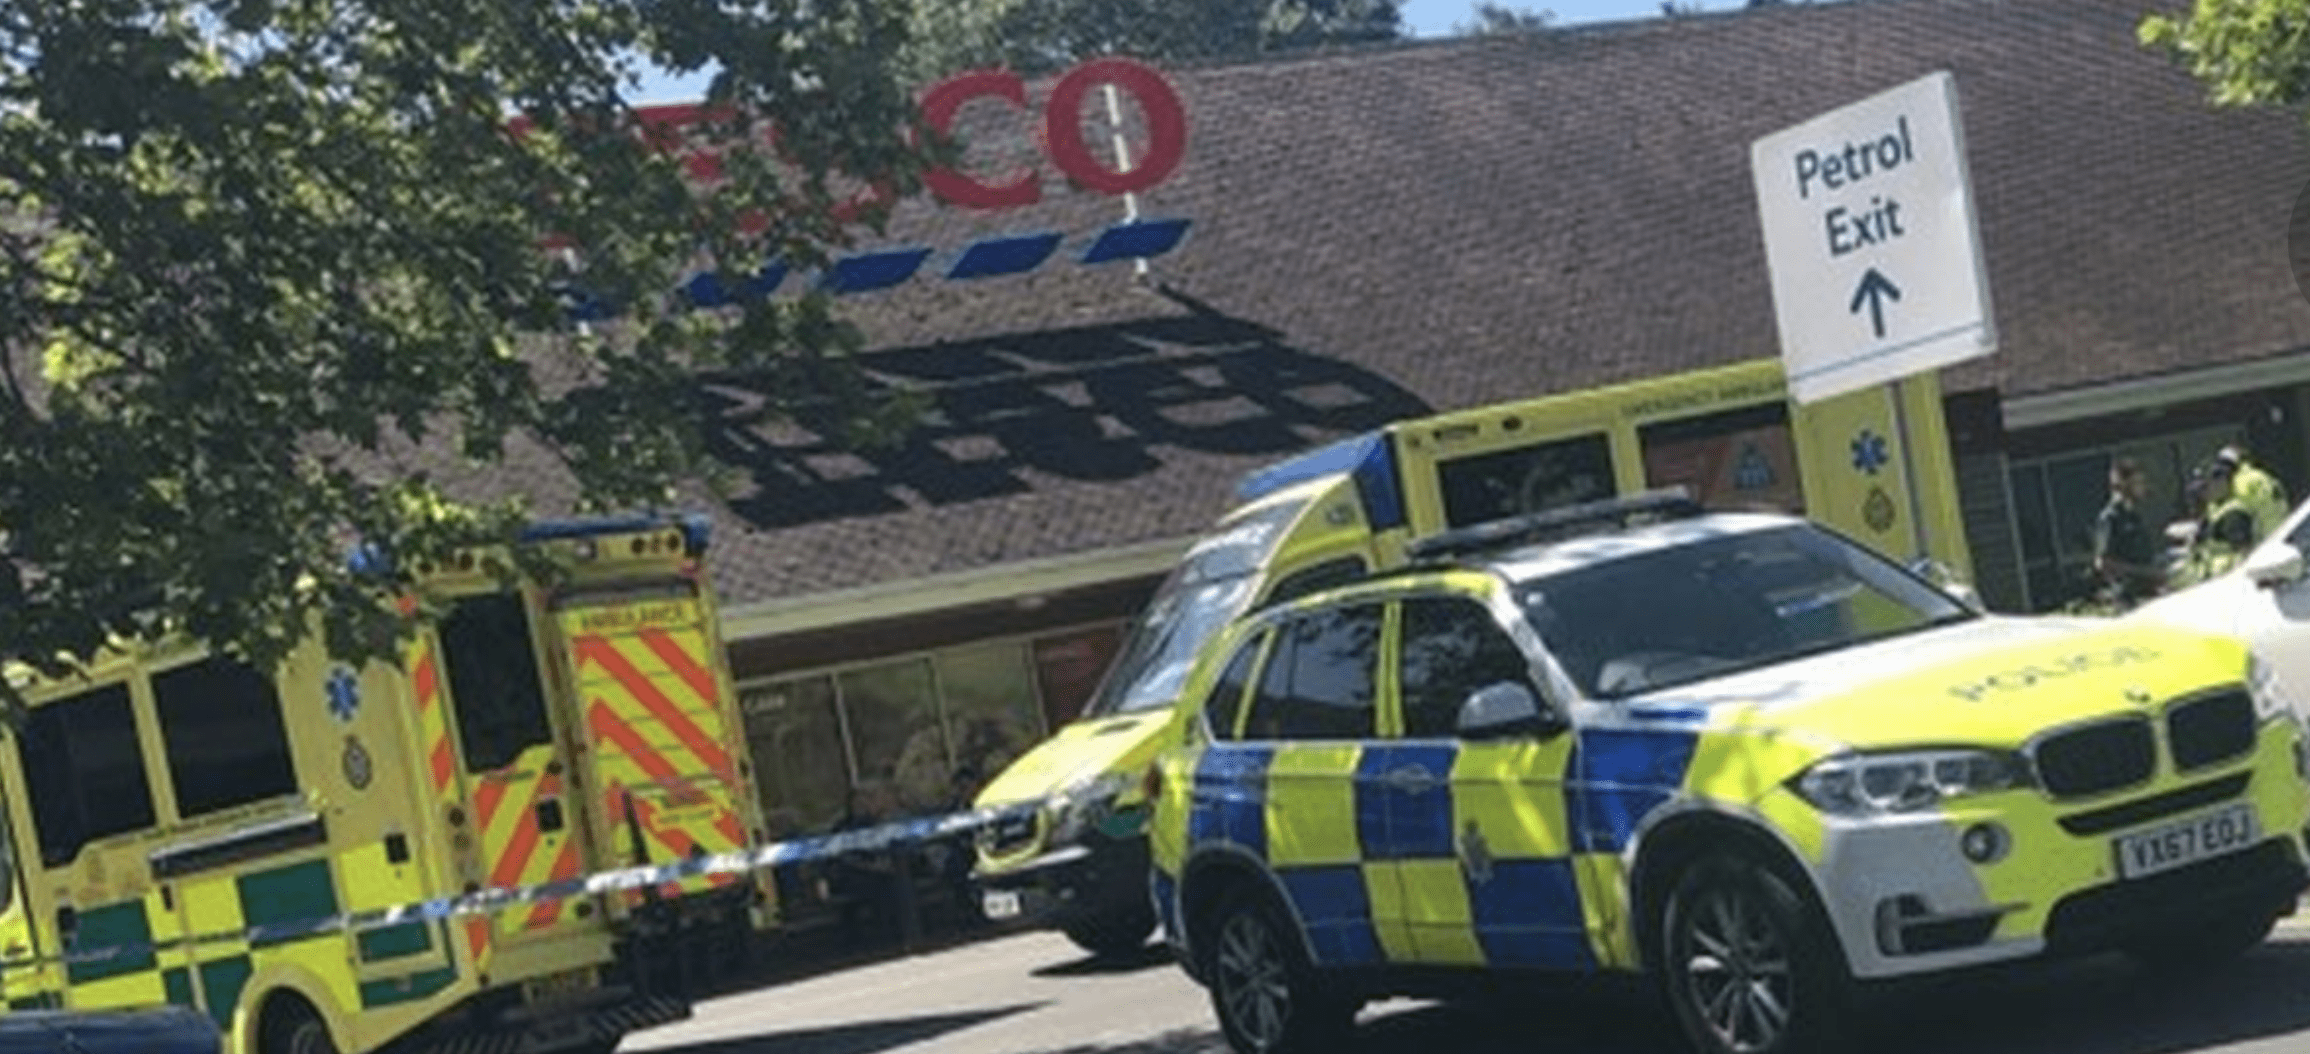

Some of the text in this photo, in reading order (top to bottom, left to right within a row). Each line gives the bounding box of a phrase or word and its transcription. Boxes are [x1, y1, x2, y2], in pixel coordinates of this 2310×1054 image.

[1795, 115, 1912, 199] Petrol
[1825, 196, 1904, 256] Exit
[1947, 645, 2163, 703] POLICE
[2127, 812, 2250, 868] VX67 EOJ
